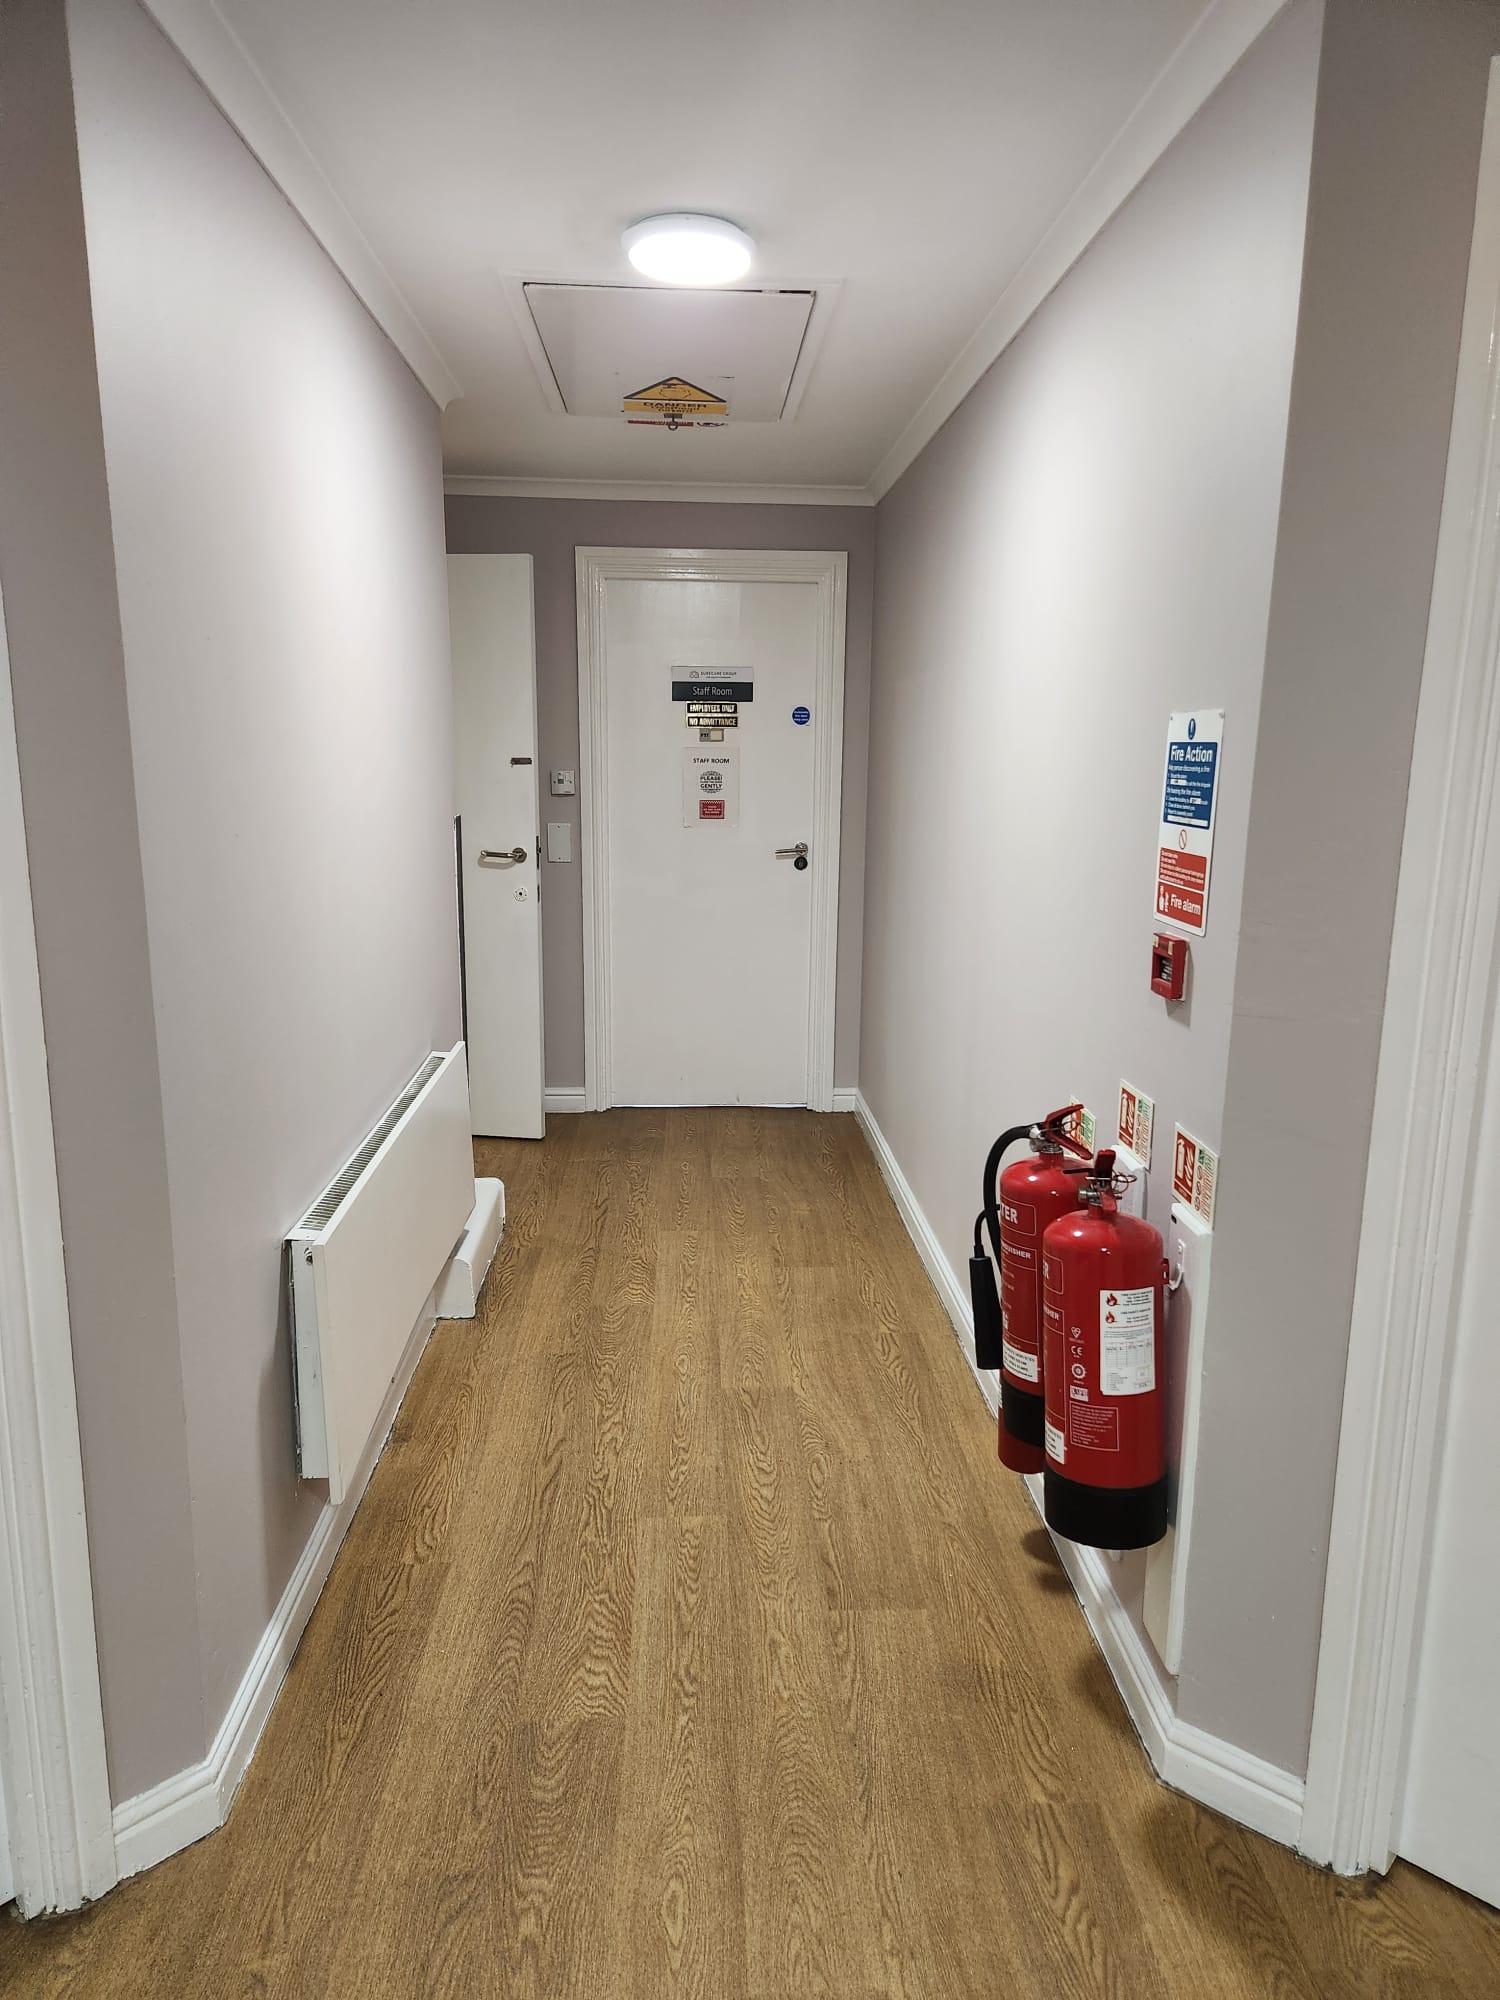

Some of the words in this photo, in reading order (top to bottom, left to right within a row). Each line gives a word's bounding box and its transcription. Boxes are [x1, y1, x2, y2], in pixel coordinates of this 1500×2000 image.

[692, 686, 711, 696] Staff
[711, 686, 733, 696] Room
[690, 704, 720, 712] EMPLOYEES
[721, 704, 735, 712] ONLY
[689, 717, 698, 726] NO
[699, 717, 737, 726] ADMITTANCE
[1171, 745, 1184, 761] Fire
[1185, 746, 1212, 762] Action
[1170, 893, 1182, 909] Fire
[1182, 898, 1201, 915] alarm
